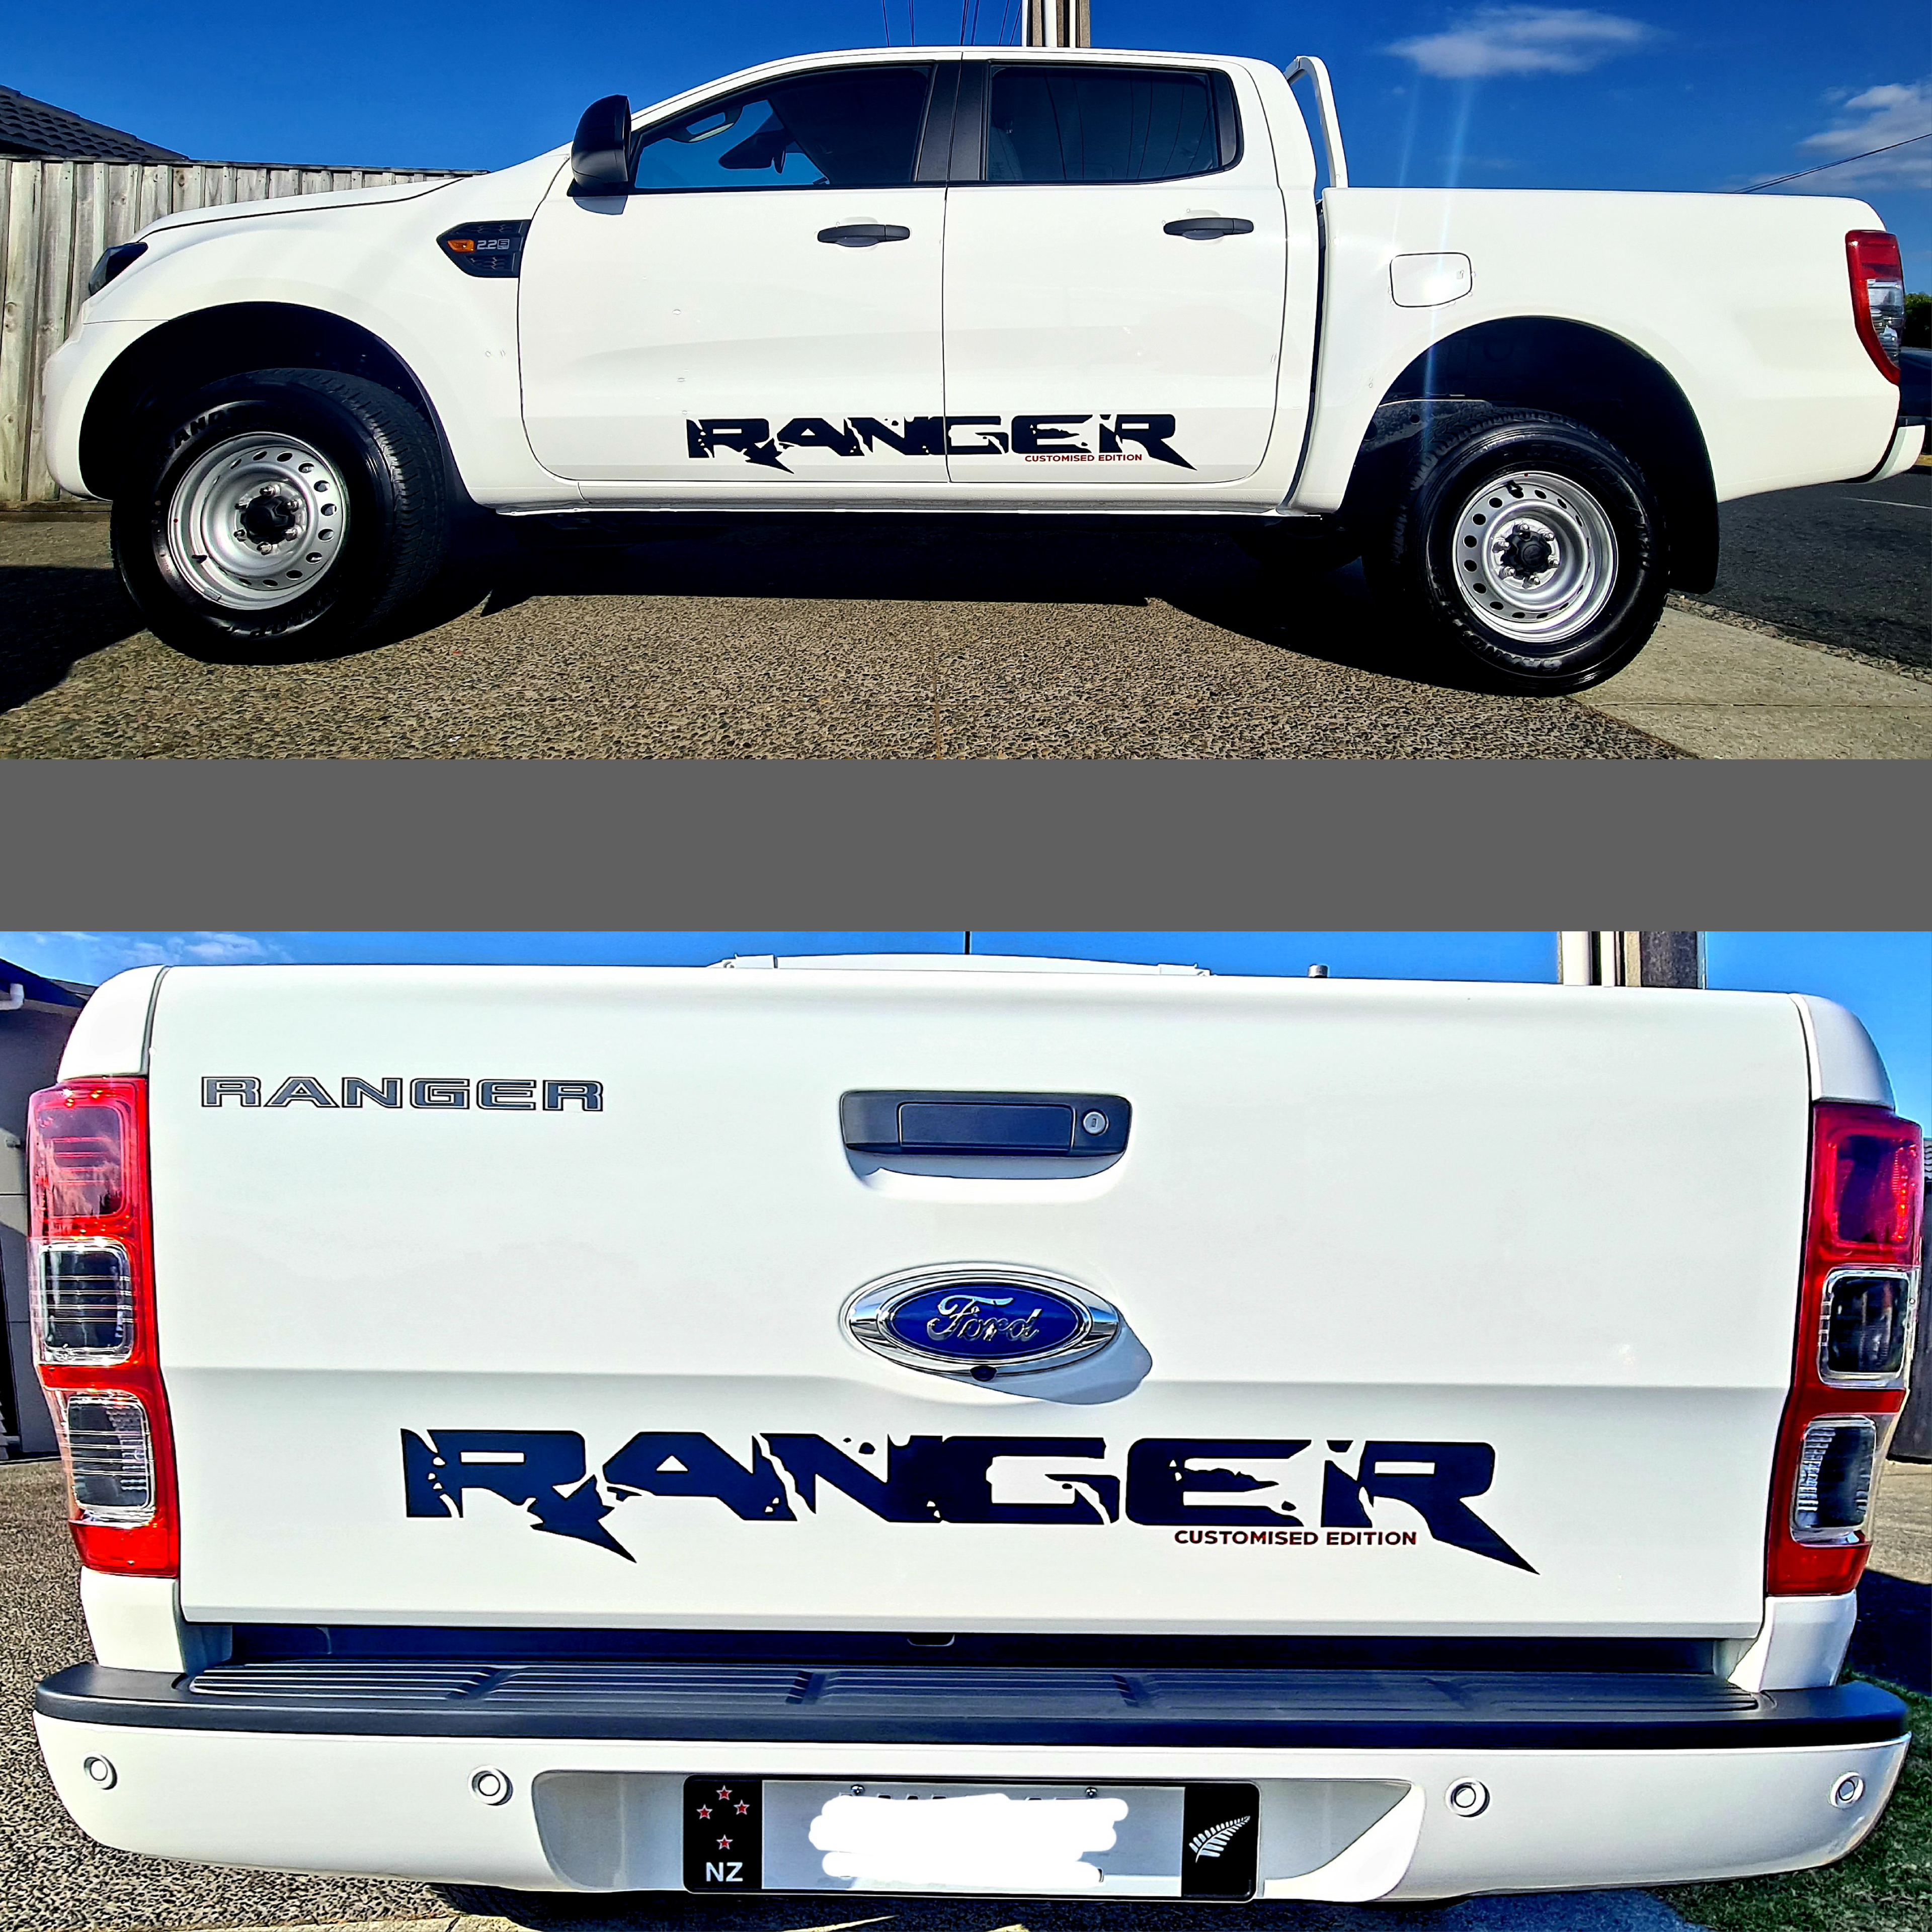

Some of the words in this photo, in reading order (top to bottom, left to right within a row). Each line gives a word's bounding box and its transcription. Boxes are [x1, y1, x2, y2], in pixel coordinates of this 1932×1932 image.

[686, 414, 1197, 474] RANGER
[1098, 454, 1143, 462] EDITION
[201, 1076, 604, 1112] RANGER
[927, 1294, 1043, 1342] Ford
[400, 1428, 1540, 1575] RANGER
[1174, 1530, 1319, 1545] CUSTOMISED
[1326, 1531, 1417, 1546] EDITION
[705, 1861, 744, 1883] NZ
